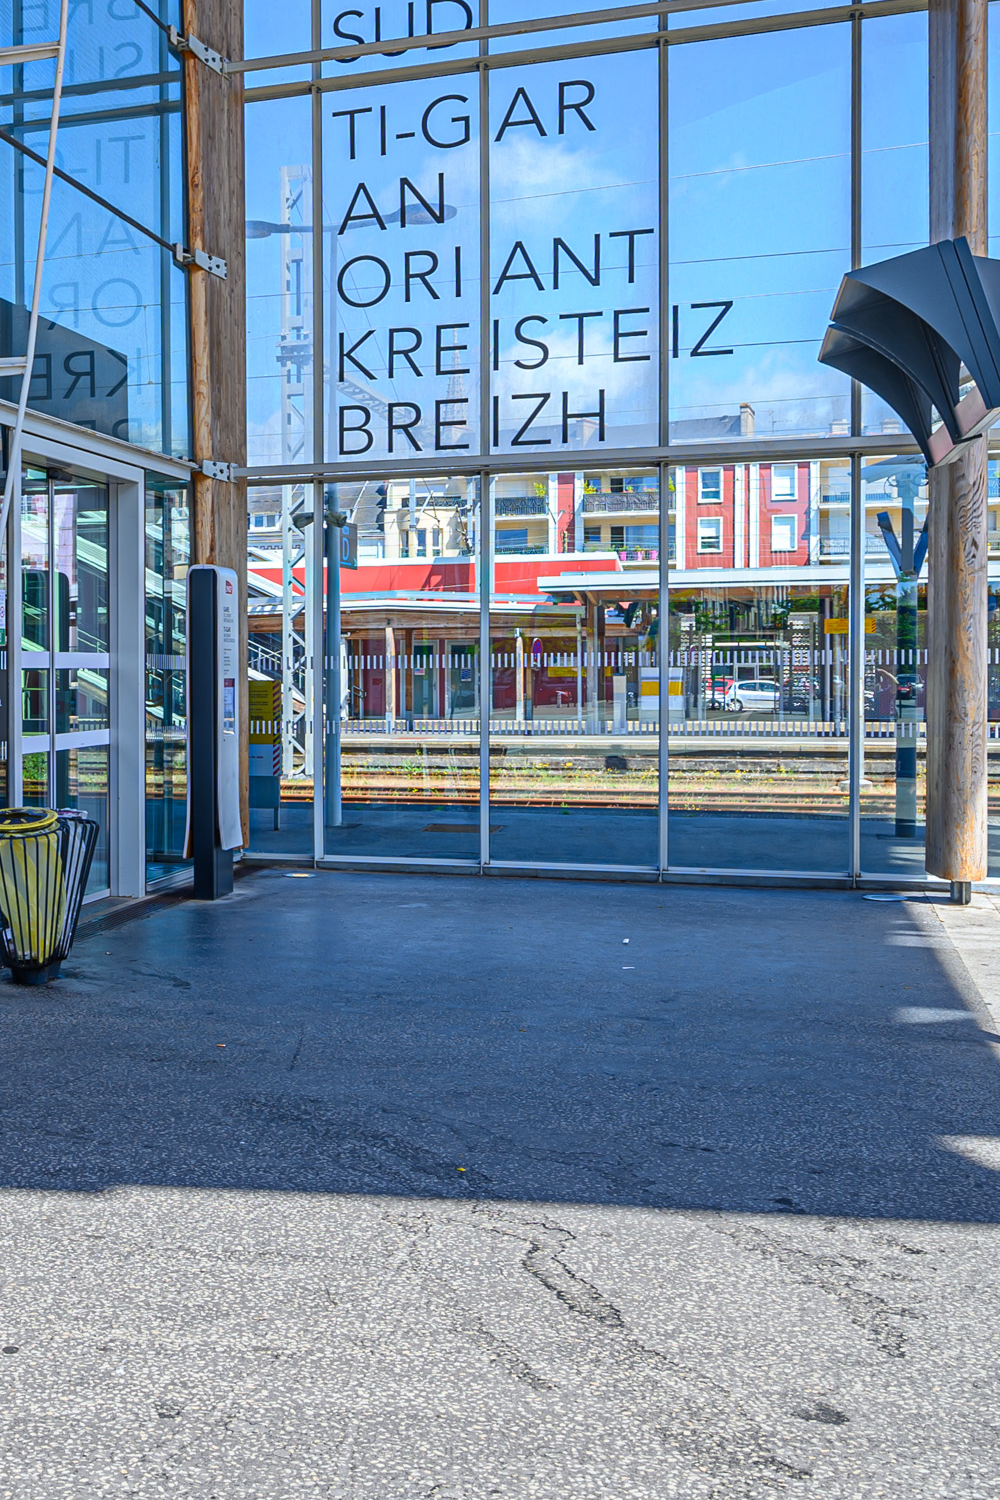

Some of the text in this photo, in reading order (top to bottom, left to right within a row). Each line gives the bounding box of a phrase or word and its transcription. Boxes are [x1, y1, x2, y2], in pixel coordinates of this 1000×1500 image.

[333, 79, 597, 161] TI-GAR
[337, 172, 446, 236] AN
[337, 228, 655, 309] ORIANT
[338, 300, 734, 383] KREISTEIZ
[338, 389, 606, 456] BREIZH
